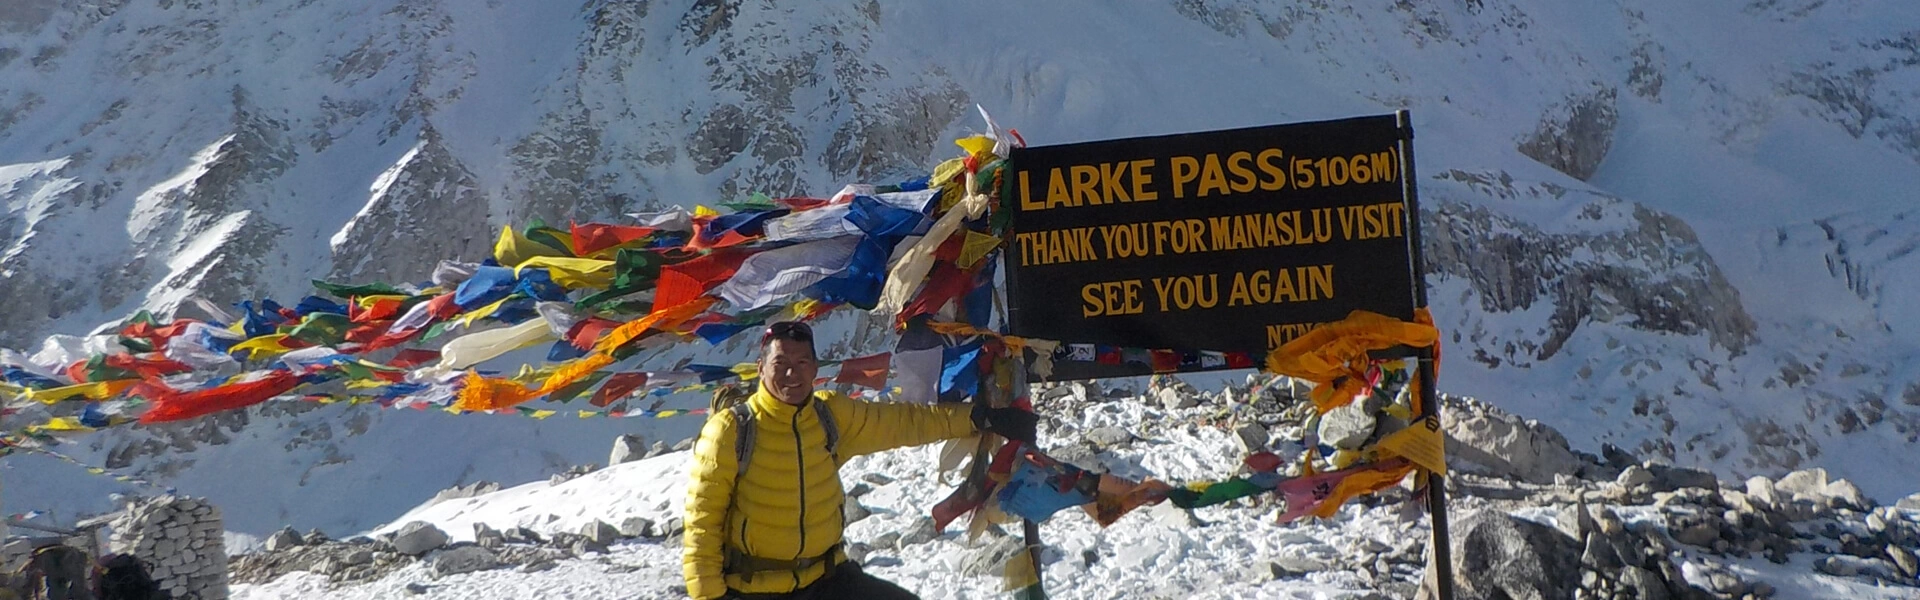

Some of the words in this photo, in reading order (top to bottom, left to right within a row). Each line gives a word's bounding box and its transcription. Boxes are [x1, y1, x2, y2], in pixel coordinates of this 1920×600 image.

[1018, 158, 1158, 212] LARKE
[1171, 148, 1287, 199] PASS
[1290, 146, 1398, 190] (5106M)
[1017, 226, 1098, 266] THANK
[1101, 222, 1149, 259] YOU
[1153, 219, 1207, 256] FOR
[1208, 208, 1332, 251] MANASLU
[1337, 202, 1404, 240] VISIT
[1082, 280, 1144, 318] SEE
[1153, 273, 1218, 311] YOU
[1229, 264, 1334, 305] AGAIN
